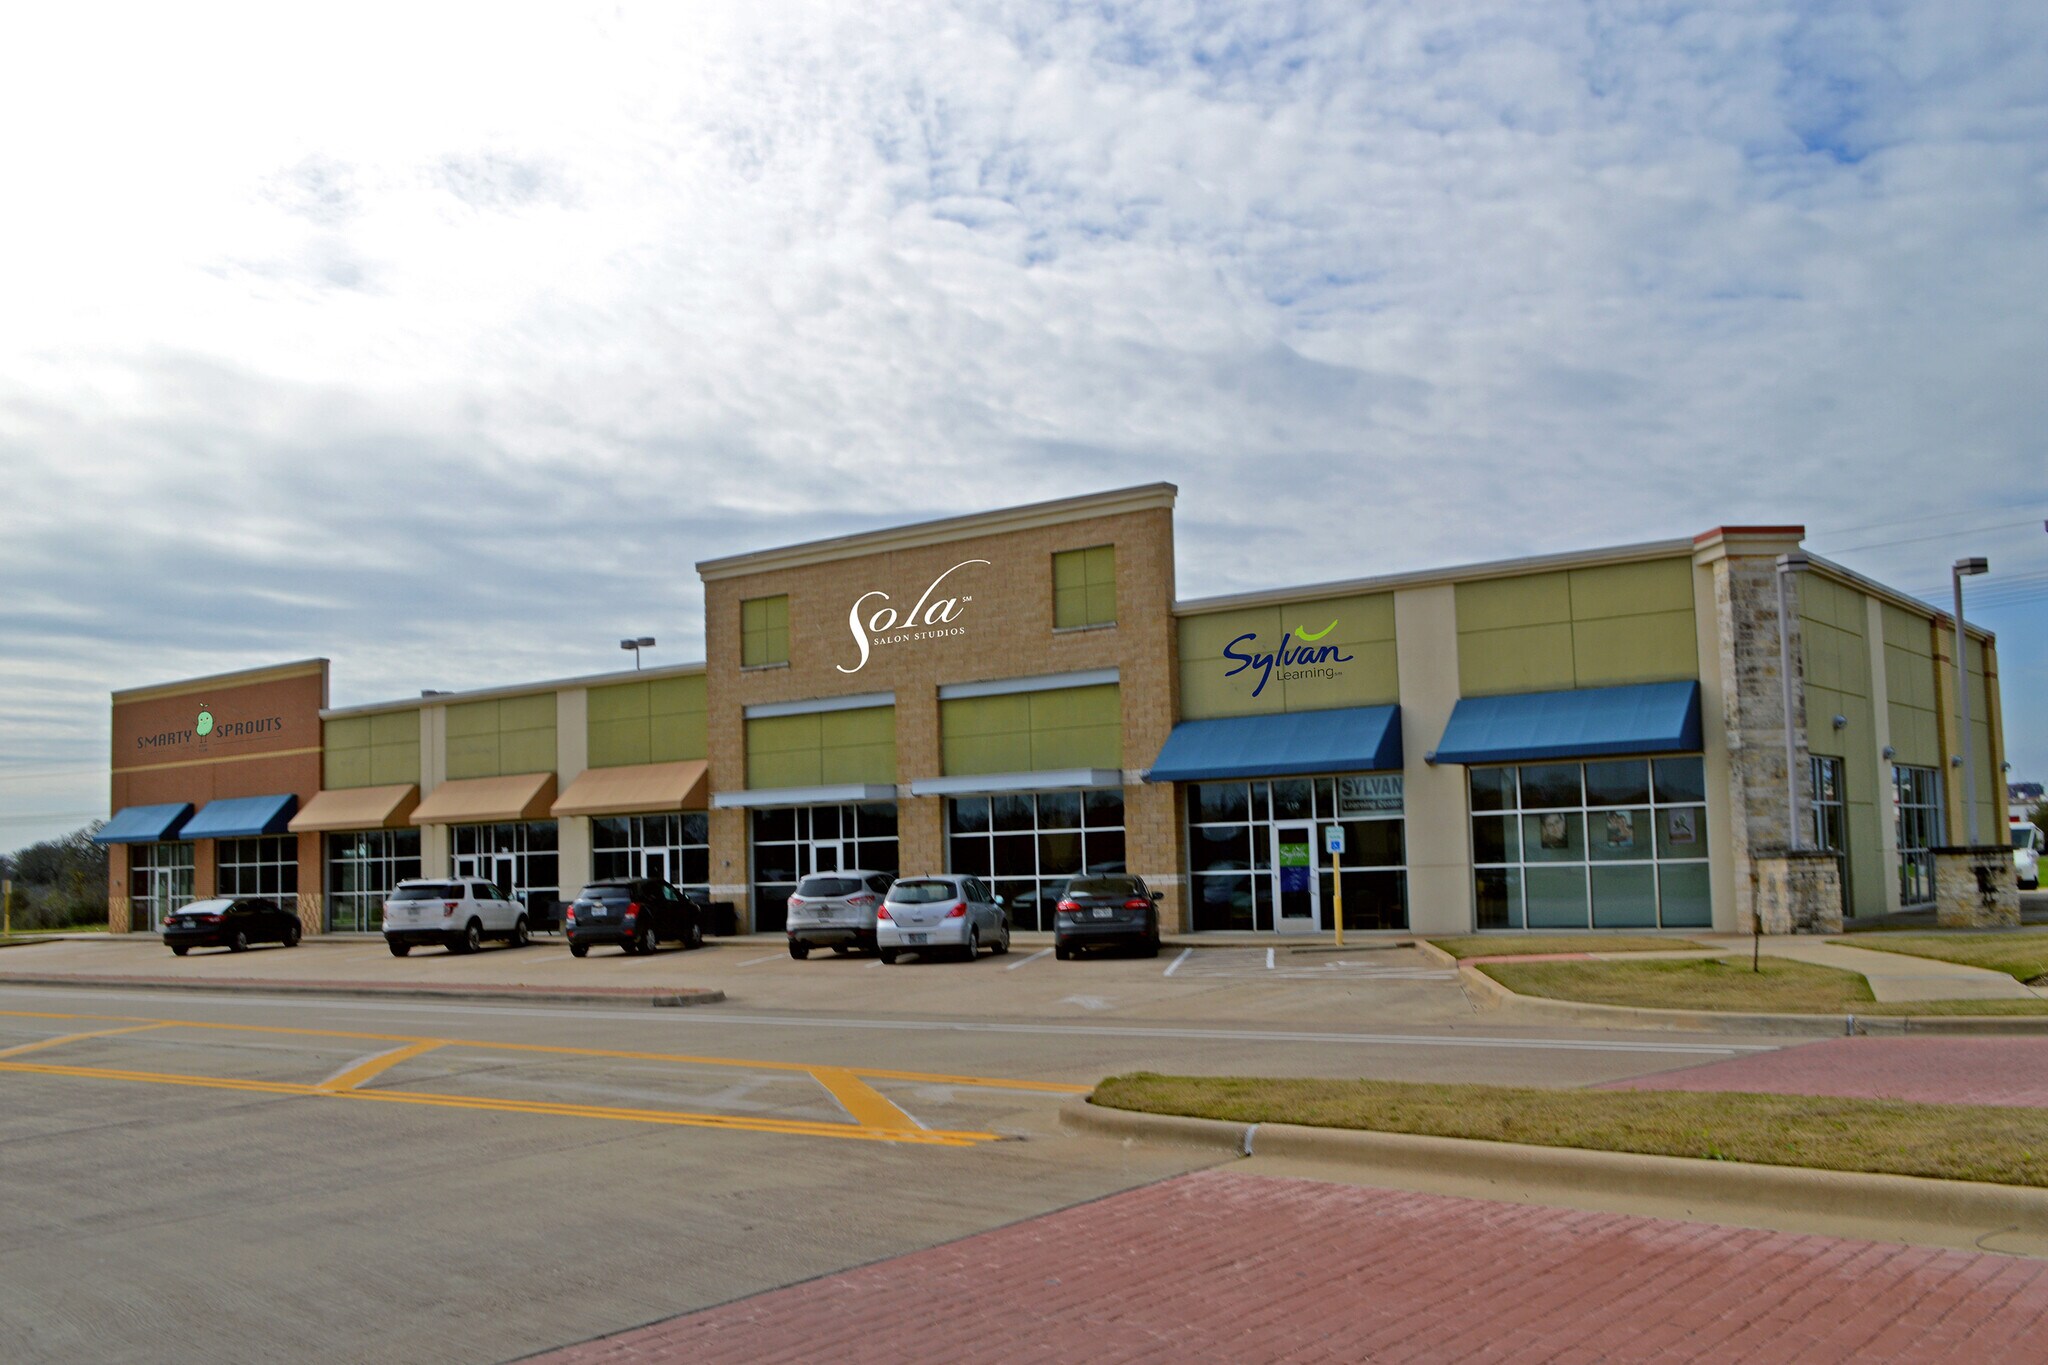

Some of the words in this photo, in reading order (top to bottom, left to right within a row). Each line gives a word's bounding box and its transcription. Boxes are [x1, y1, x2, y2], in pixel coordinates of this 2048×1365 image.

[836, 559, 991, 674] Sola
[873, 633, 910, 646] SALON
[914, 627, 966, 641] STUDIOS
[1223, 632, 1354, 698] Sylvan
[1276, 667, 1334, 681] Learning
[137, 729, 193, 749] SMARTY
[216, 716, 282, 738] SPROUTS
[1342, 776, 1403, 797] SYLVAN
